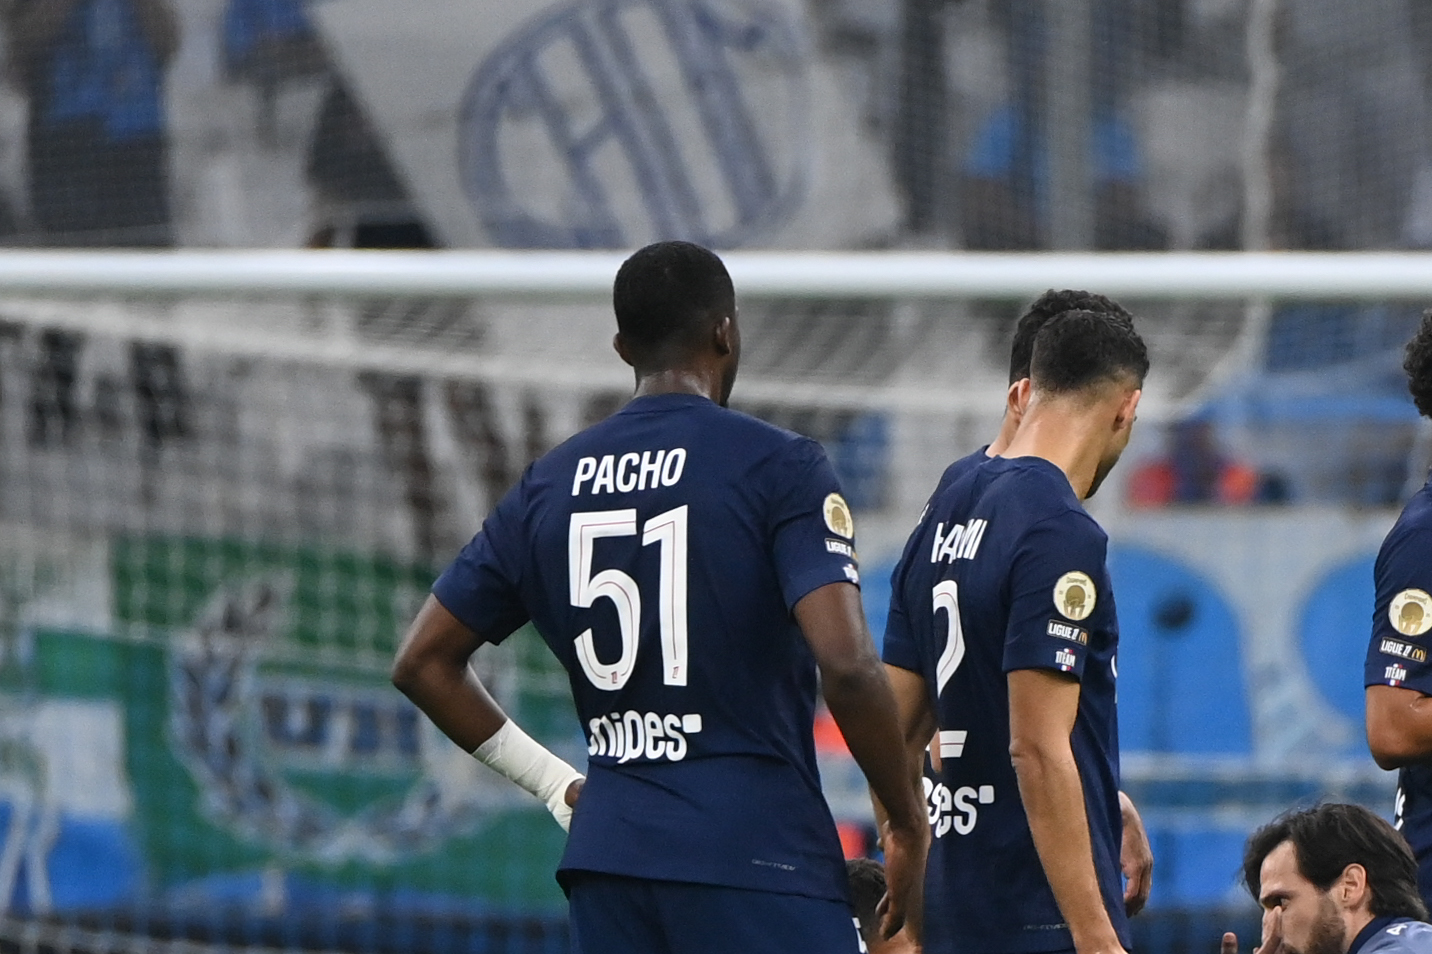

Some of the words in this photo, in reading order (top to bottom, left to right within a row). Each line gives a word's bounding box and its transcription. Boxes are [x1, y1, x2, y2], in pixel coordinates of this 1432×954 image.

[571, 447, 688, 497] PACHO
[568, 504, 689, 691] 51
[1048, 622, 1072, 640] LIGUE
[1380, 639, 1404, 655] LIGUE
